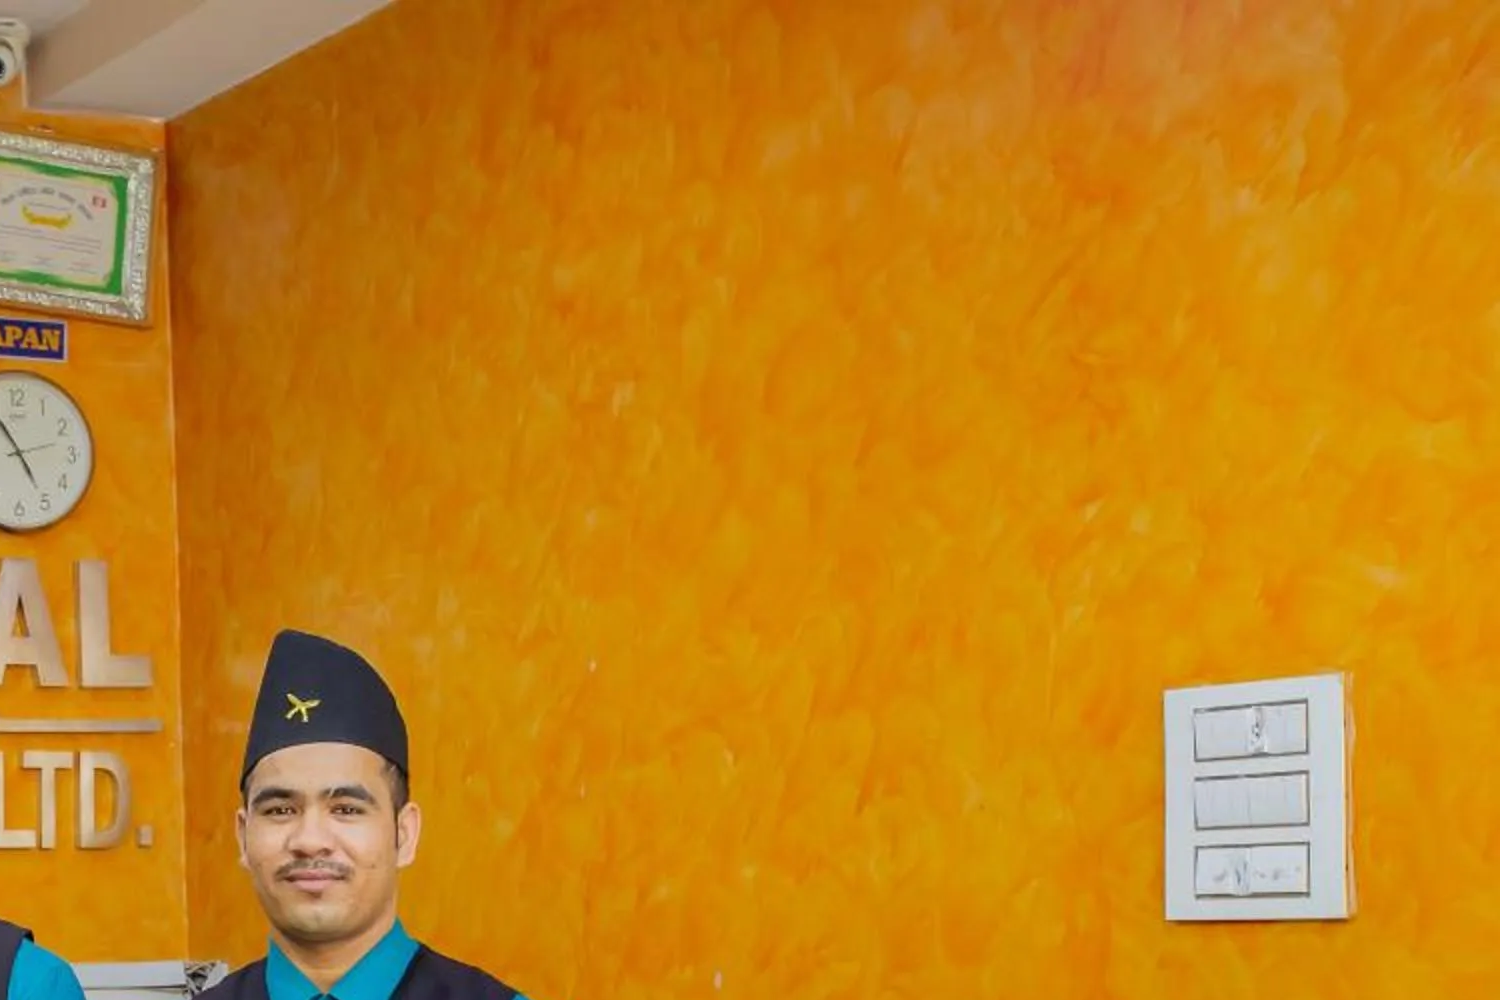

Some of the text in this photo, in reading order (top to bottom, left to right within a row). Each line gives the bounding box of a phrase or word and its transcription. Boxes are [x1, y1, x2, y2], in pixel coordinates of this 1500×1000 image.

[9, 388, 26, 407] 12
[57, 418, 69, 437] 2
[67, 446, 78, 464] 3
[57, 473, 68, 492] 4
[14, 500, 26, 517] 6
[39, 494, 50, 511] 5
